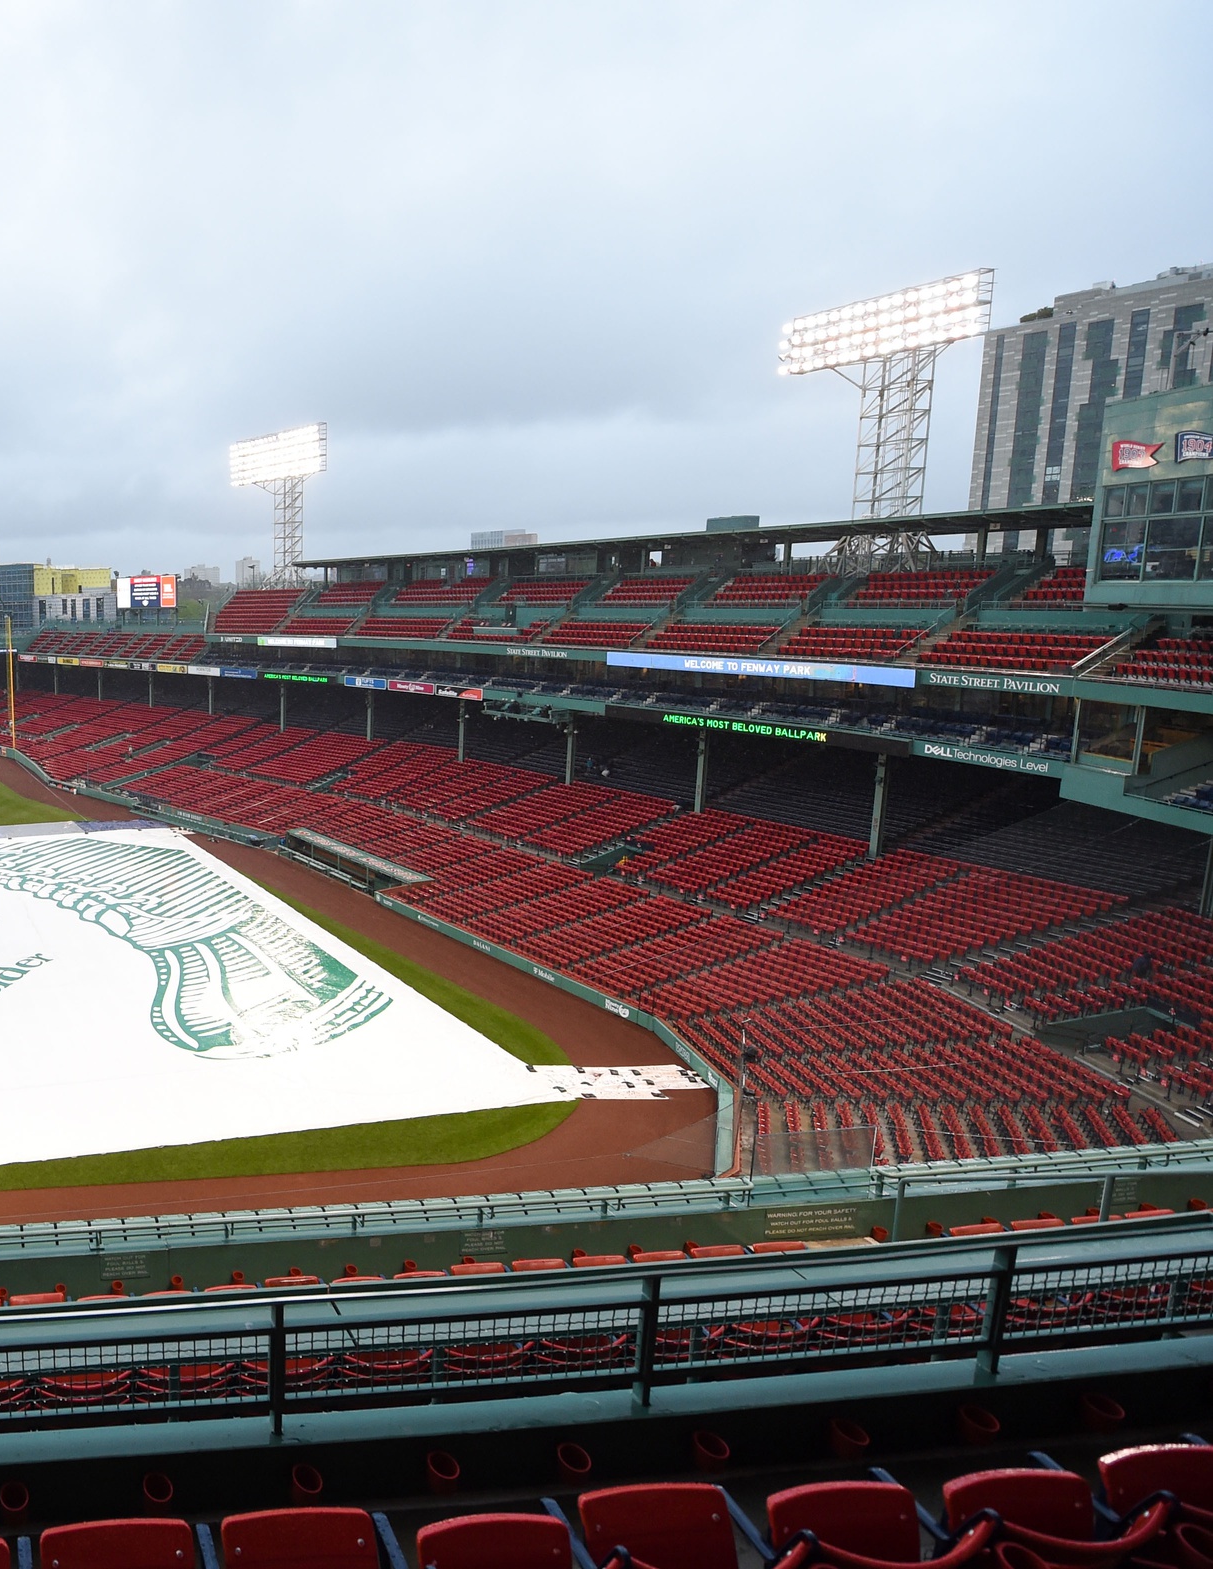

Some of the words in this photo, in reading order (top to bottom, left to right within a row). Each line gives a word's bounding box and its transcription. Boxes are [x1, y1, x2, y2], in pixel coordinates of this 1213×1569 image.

[1182, 439, 1212, 452] 1904
[522, 648, 540, 657] STREET
[541, 650, 567, 658] PAVILION
[684, 659, 724, 671] WELCOME
[727, 661, 738, 671] TO
[741, 662, 780, 674] FENWAY
[783, 665, 811, 676] PARK
[929, 673, 959, 686] STATE
[961, 675, 1000, 689] STREET
[1003, 678, 1060, 694] PAVILION
[663, 714, 704, 727] AMERICA'S
[706, 718, 729, 729] MOST
[732, 721, 772, 735] BELOVED
[775, 727, 827, 742] BALLPARK
[952, 748, 1017, 768] Technologies
[1020, 758, 1049, 773] Level
